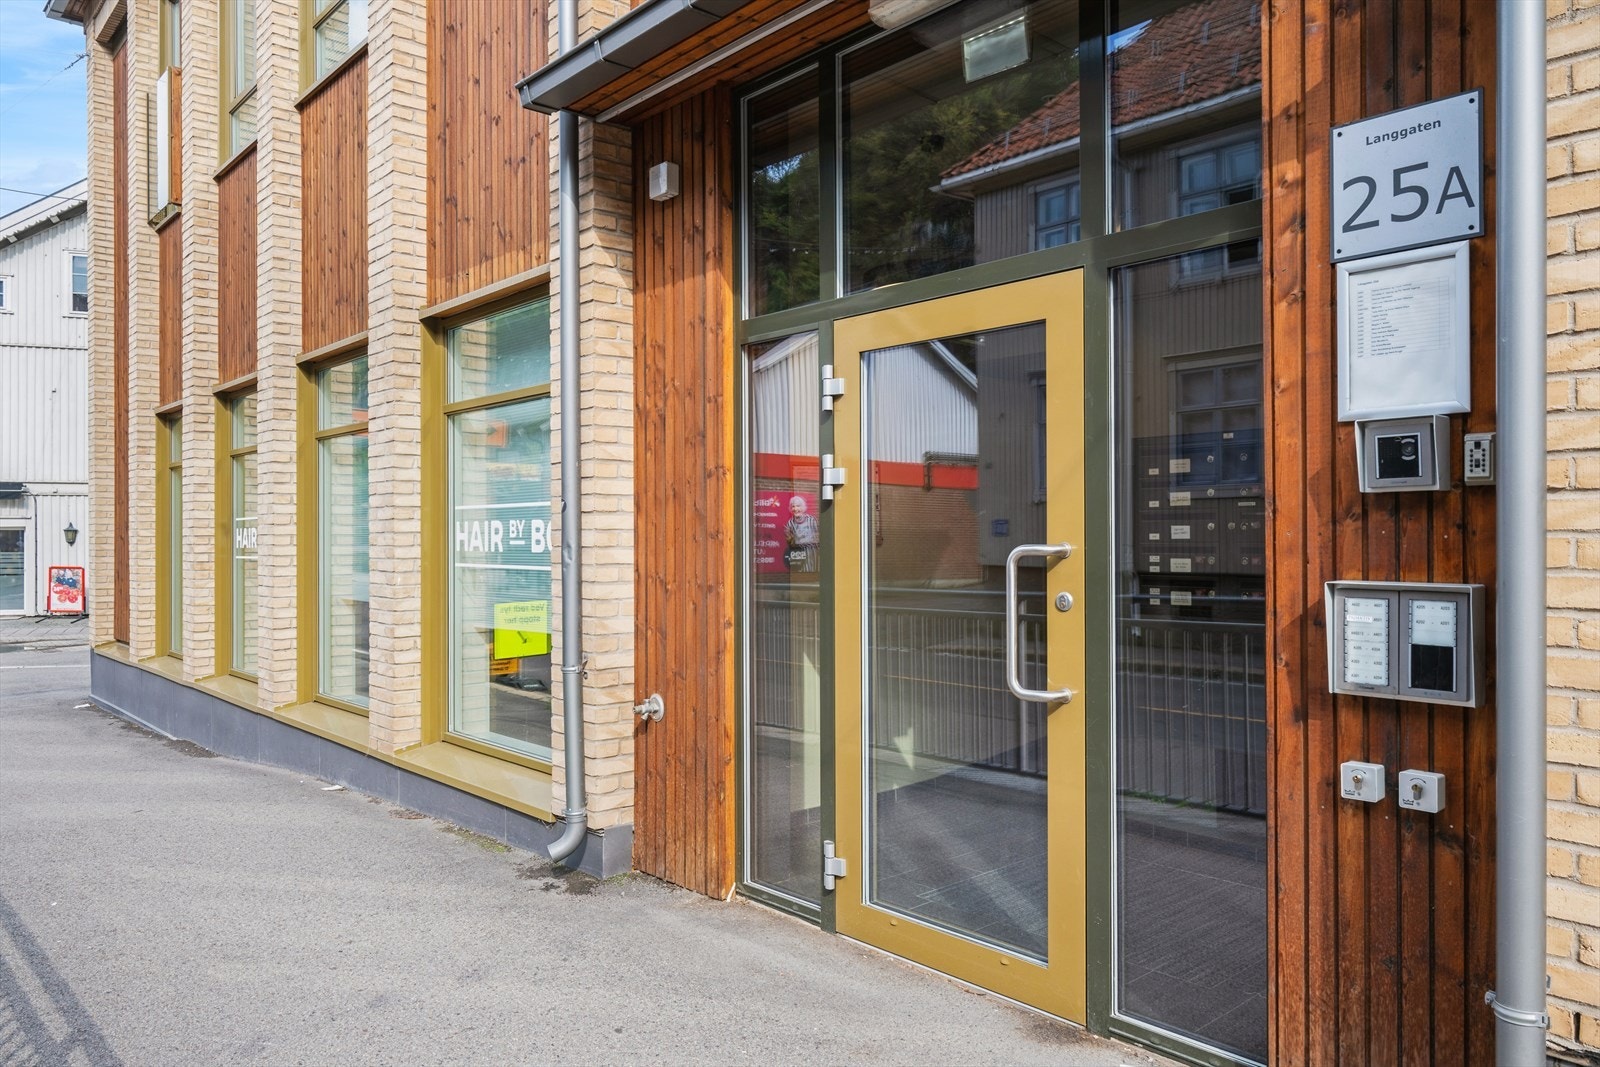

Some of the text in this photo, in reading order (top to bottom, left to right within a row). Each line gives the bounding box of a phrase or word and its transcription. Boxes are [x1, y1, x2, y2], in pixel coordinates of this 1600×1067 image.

[1365, 119, 1442, 146] Langgaten
[1342, 161, 1476, 234] 25A
[236, 527, 257, 549] HAIR
[456, 520, 504, 552] HAIR
[509, 519, 525, 538] BY
